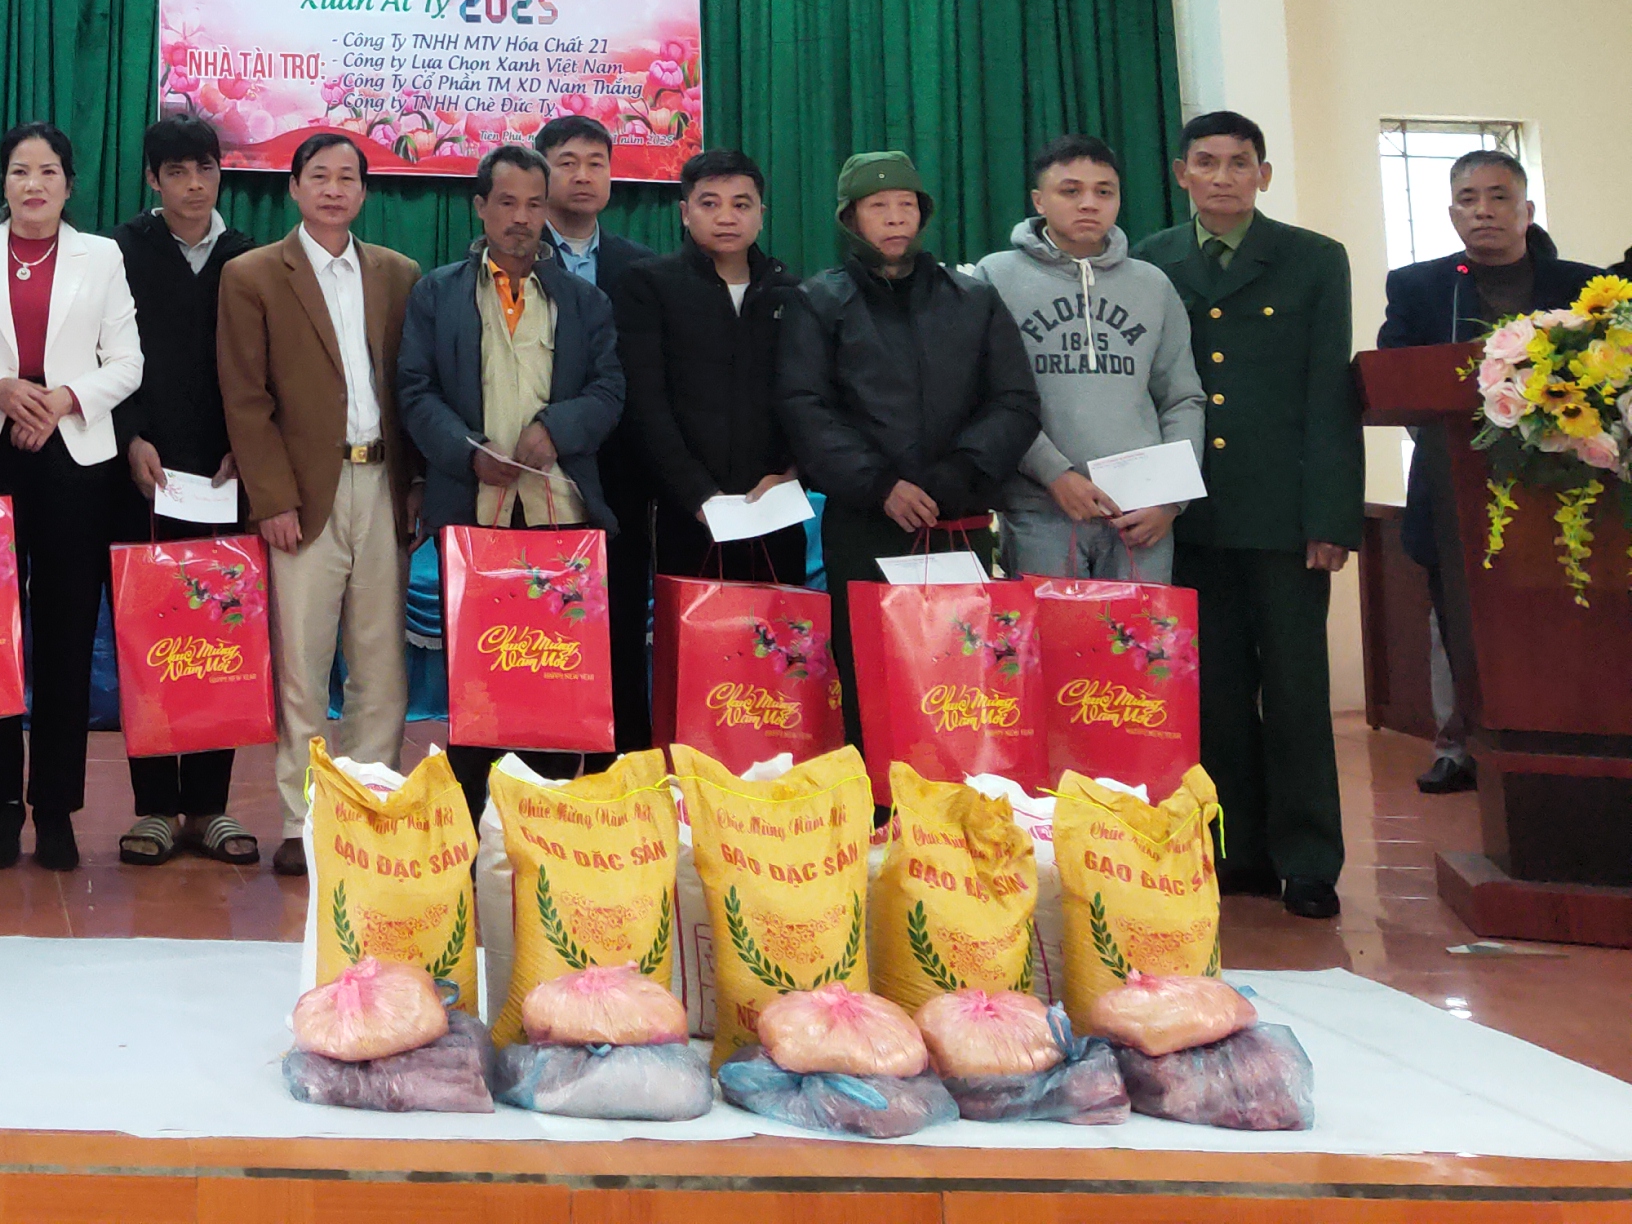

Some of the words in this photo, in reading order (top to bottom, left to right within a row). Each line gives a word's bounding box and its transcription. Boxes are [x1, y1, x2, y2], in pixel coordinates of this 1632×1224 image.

[343, 31, 384, 51] Công
[391, 33, 406, 51] Ty
[412, 33, 459, 50] TNHH
[464, 35, 502, 51] MTV
[505, 35, 539, 52] Hóa
[545, 35, 585, 53] Chất
[588, 38, 608, 54] 21
[187, 46, 234, 78] NHÀ
[239, 47, 273, 79] TÀI
[280, 52, 326, 85] TRỢ:
[343, 52, 384, 71] Công
[390, 55, 406, 72] ty
[412, 54, 442, 73] Lựa
[448, 55, 490, 73] Chọn
[496, 56, 540, 72] Xanh
[547, 57, 579, 76] Việt
[583, 59, 623, 74] Nam
[343, 72, 384, 92] Công
[391, 75, 406, 92] Ty
[412, 73, 435, 90] Cổ
[438, 73, 475, 92] Phần
[487, 77, 510, 92] TM
[516, 77, 541, 93] XD
[547, 78, 587, 94] Nam
[592, 78, 643, 97] Thắng
[343, 92, 384, 112] Công
[390, 95, 406, 112] ty
[412, 94, 460, 112] TNHH
[465, 95, 496, 113] Chè
[501, 96, 533, 114] Đức
[1021, 293, 1147, 347] FLORIDA
[1035, 353, 1135, 376] ORLANDO
[334, 834, 369, 870] GẠO
[376, 854, 421, 882] ĐẶC
[429, 841, 469, 874] SẢN
[573, 849, 624, 873] ĐẶC
[630, 836, 667, 865] SẢN
[721, 843, 761, 876] GẠO
[768, 863, 819, 888] ĐẶC
[824, 841, 858, 876] SẢN
[909, 857, 956, 891] GẠO
[1084, 850, 1132, 883] GẠO
[1141, 870, 1185, 898] ĐẶC
